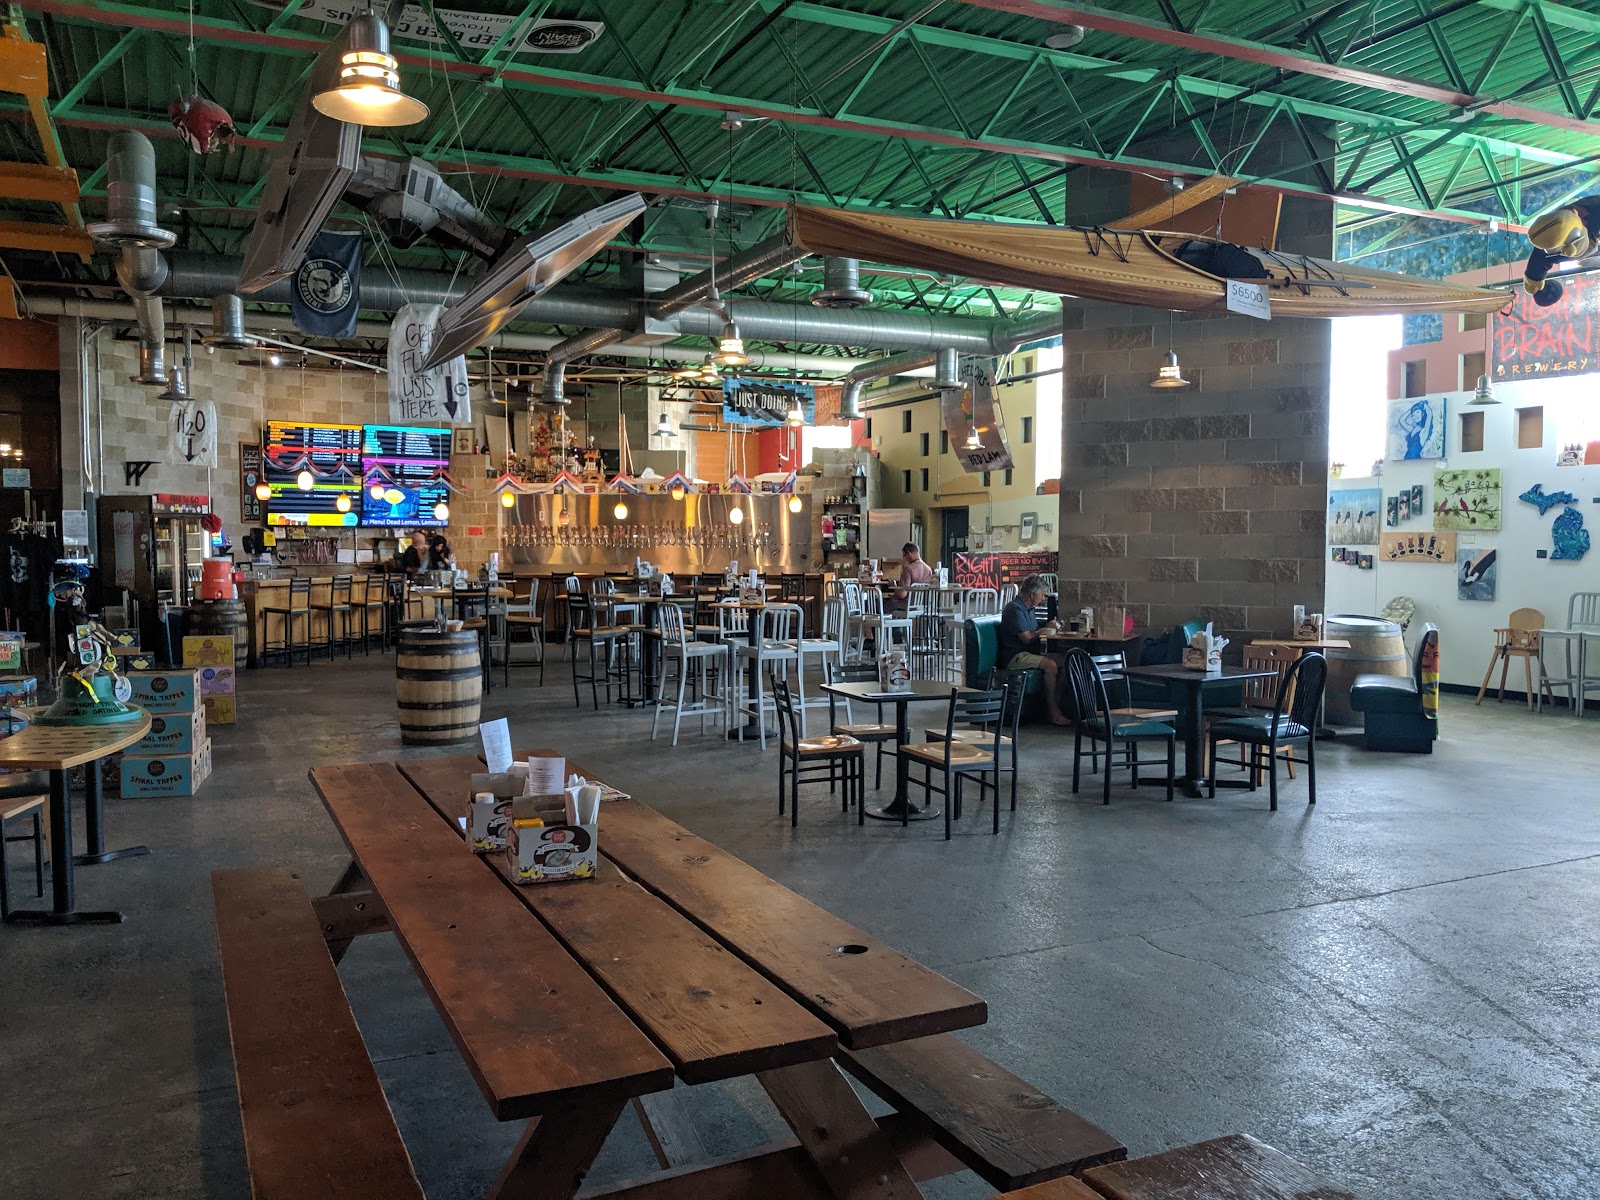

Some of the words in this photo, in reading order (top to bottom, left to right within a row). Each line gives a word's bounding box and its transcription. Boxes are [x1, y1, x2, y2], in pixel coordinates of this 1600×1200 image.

[538, 32, 583, 42] BRAIN
[1231, 283, 1264, 303] $6500
[405, 323, 436, 348] GRA
[1494, 316, 1592, 362] BRAIN
[1497, 357, 1588, 377] BREWERY
[399, 398, 438, 419] HERE
[736, 391, 758, 408] JUST
[761, 393, 788, 410] DOING
[175, 408, 206, 436] H2O
[955, 555, 999, 574] RIGHT
[955, 573, 1000, 592] BRAIN
[134, 692, 157, 701] SPIRAL
[159, 691, 186, 701] TAPPER
[158, 732, 184, 742] TAPPER
[130, 776, 154, 785] SPIRAL
[156, 774, 183, 784] TAPPER
